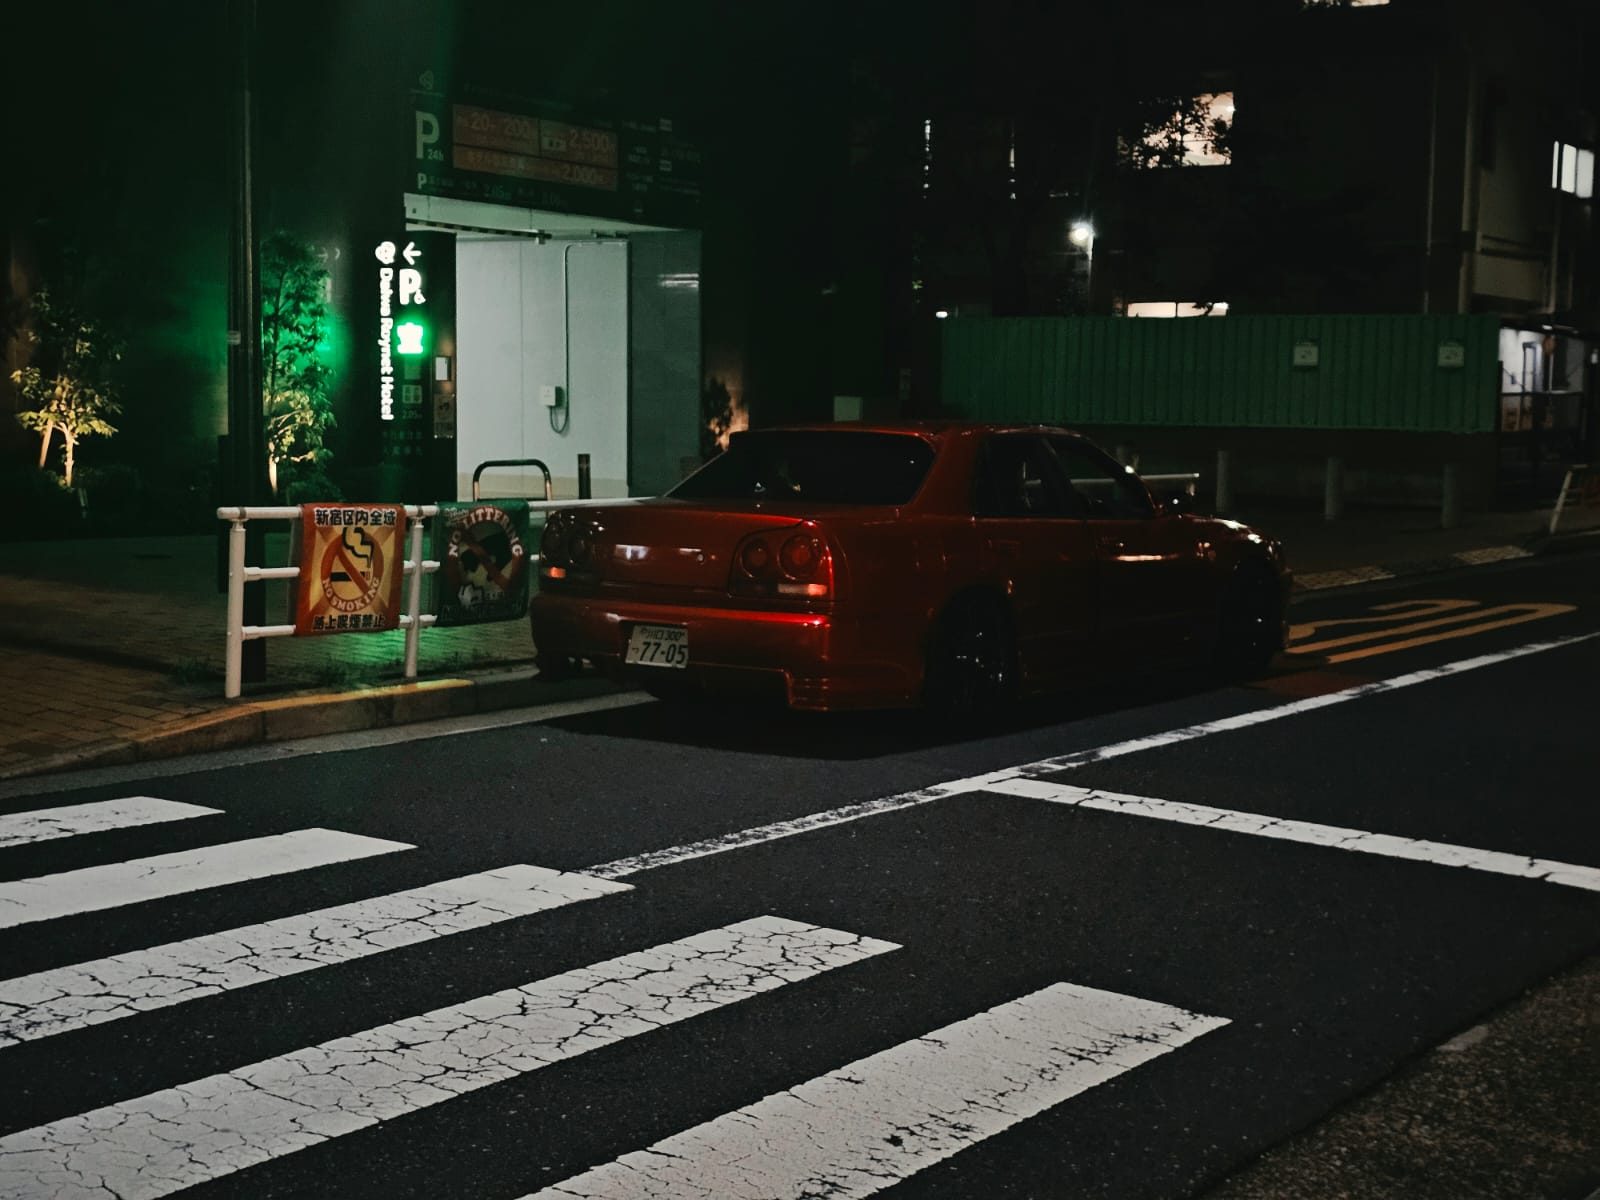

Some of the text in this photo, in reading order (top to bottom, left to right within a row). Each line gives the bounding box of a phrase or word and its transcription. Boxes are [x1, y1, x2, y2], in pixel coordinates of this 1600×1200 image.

[416, 110, 440, 159] P
[416, 172, 428, 190] P
[380, 376, 395, 421] Hotel
[314, 508, 397, 526] 新宿区内全域
[448, 530, 463, 557] NO
[462, 507, 524, 556] LITTERING
[322, 577, 379, 611] NO SMOKING
[312, 613, 386, 630] 路上喫煙禁止
